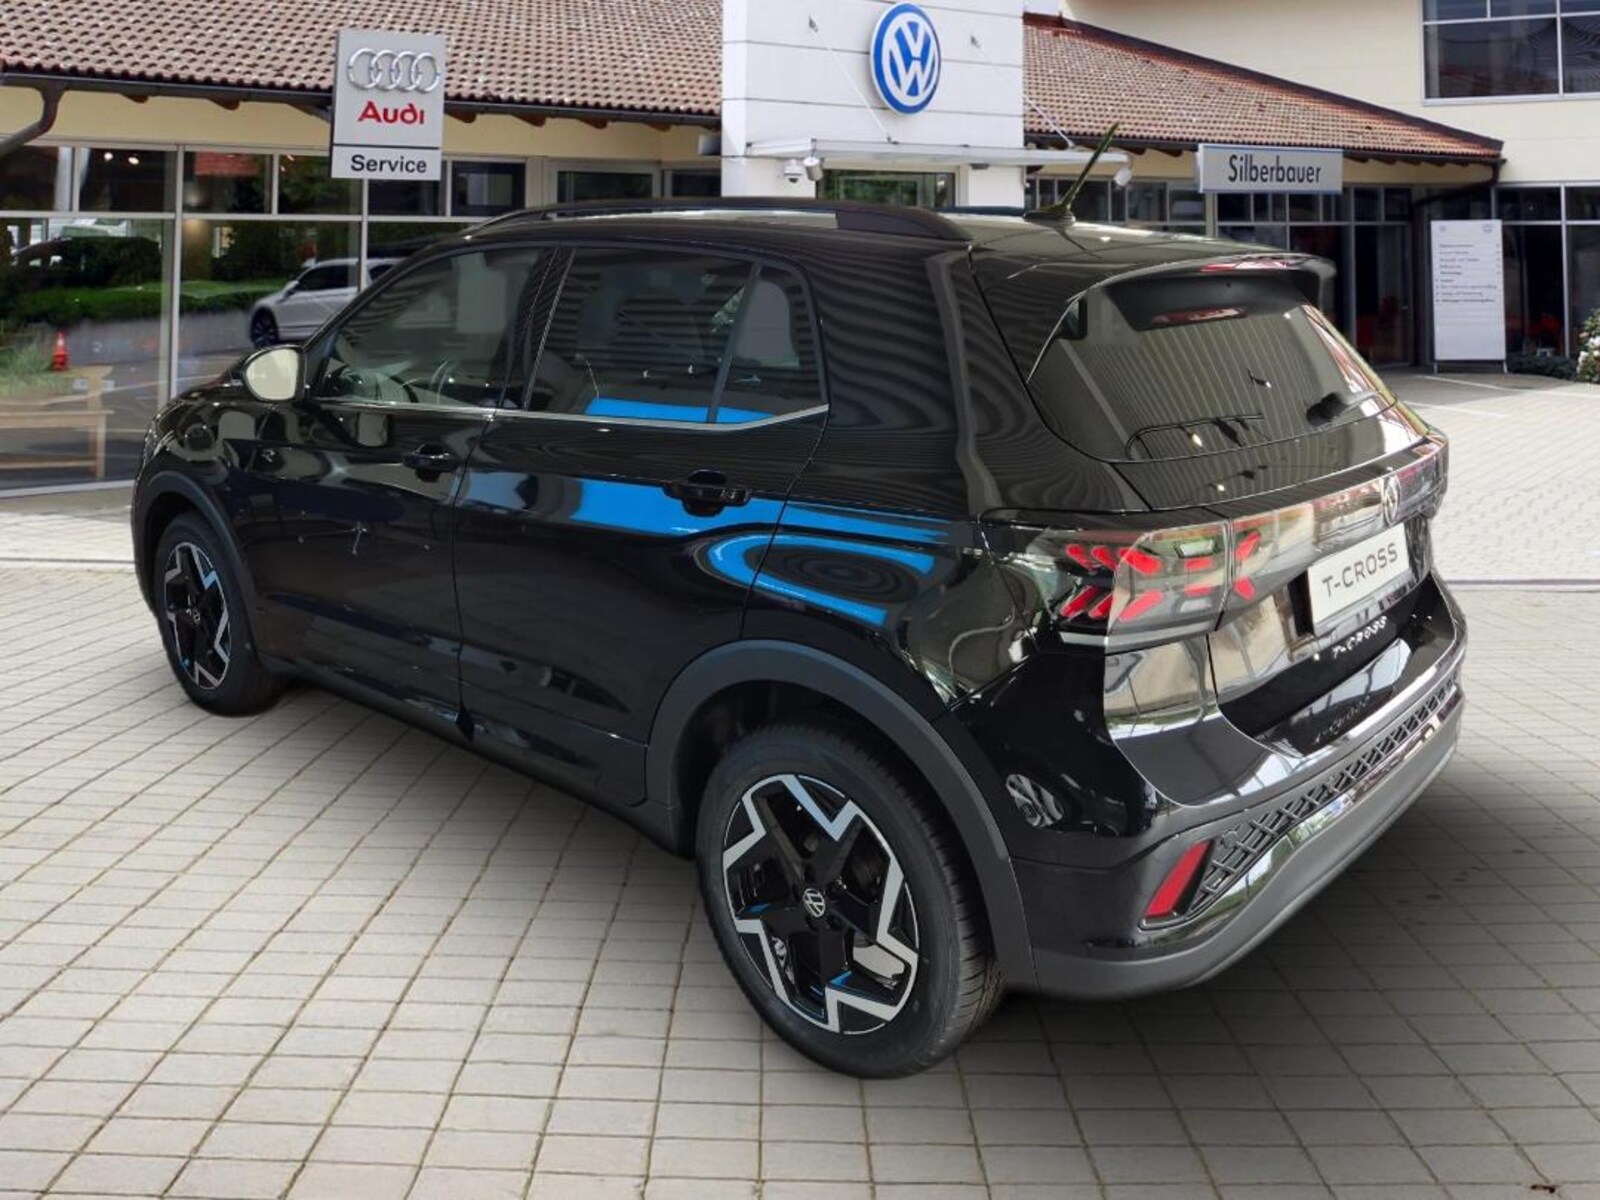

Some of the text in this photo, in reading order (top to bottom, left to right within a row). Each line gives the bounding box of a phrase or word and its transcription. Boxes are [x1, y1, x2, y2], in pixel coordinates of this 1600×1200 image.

[357, 100, 425, 125] Audi
[350, 154, 427, 173] Service
[1228, 153, 1322, 183] Silberbauer
[1322, 543, 1398, 598] T-CROSS
